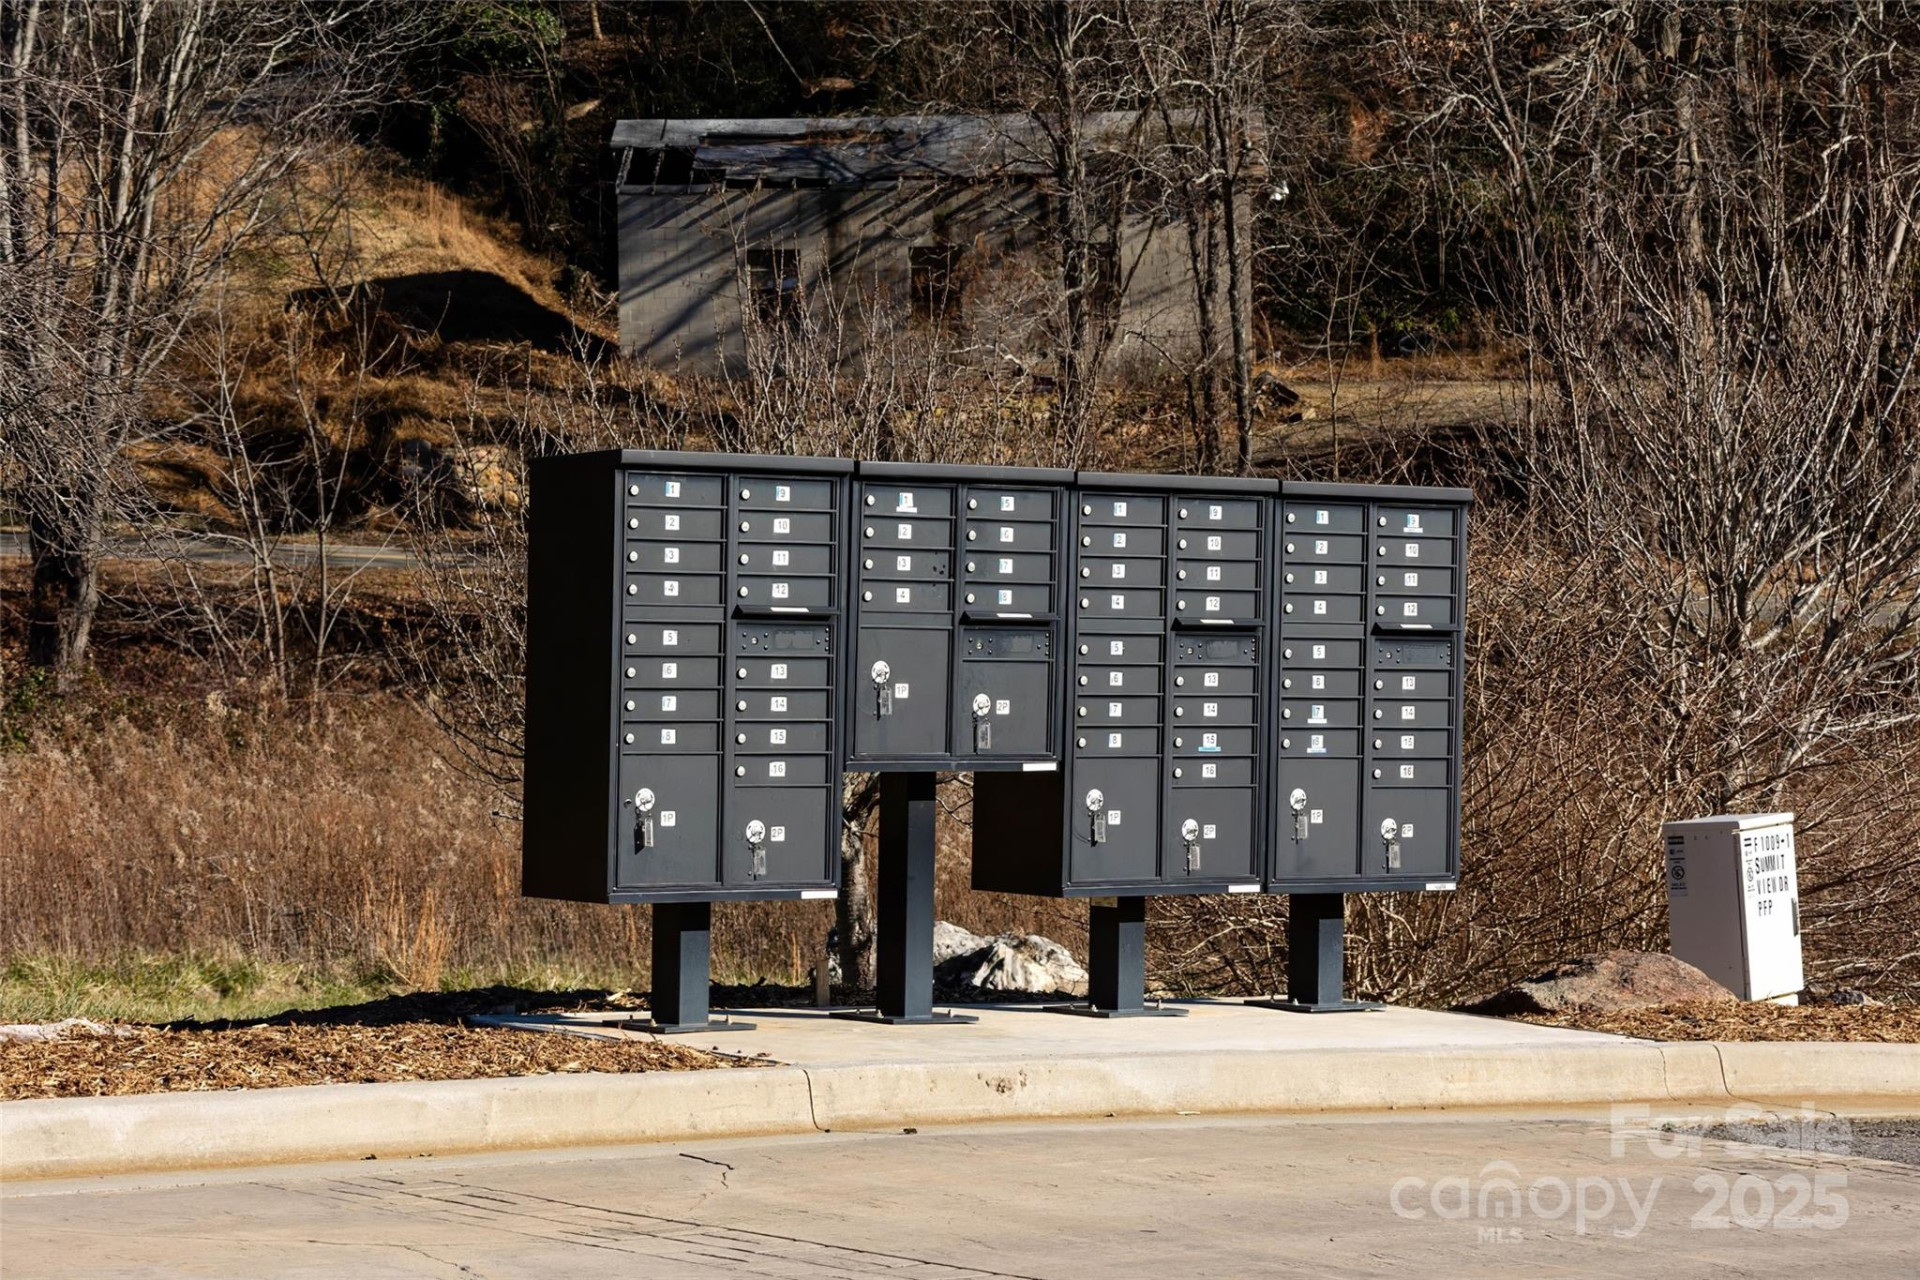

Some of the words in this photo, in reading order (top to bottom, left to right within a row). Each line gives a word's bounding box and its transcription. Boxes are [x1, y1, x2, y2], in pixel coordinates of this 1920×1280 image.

[778, 521, 788, 530] 10
[1210, 539, 1220, 547] 10
[1409, 546, 1418, 554] 10
[777, 553, 786, 562] 11
[1210, 569, 1218, 578] 11
[1408, 575, 1416, 584] 11
[776, 585, 786, 594] 12
[1209, 599, 1218, 608] 12
[1407, 605, 1416, 614] 12
[775, 667, 785, 675] 13
[1208, 675, 1216, 684] 13
[1405, 679, 1414, 687] 13
[897, 686, 907, 695] 1P
[774, 699, 785, 708] 14
[998, 702, 1008, 711] 2P
[1207, 705, 1216, 713] 14
[774, 732, 784, 741] 15
[1206, 736, 1215, 744] 15
[774, 764, 783, 773] 16
[1206, 766, 1214, 775] 16
[1403, 767, 1412, 776] 16
[663, 813, 673, 822] 1P
[1109, 812, 1119, 821] 1P
[772, 828, 783, 837] 2P
[1204, 826, 1214, 835] 2P
[1402, 826, 1412, 834] 2P
[1755, 854, 1784, 874] SUMMIT
[1758, 899, 1772, 916] PFP
